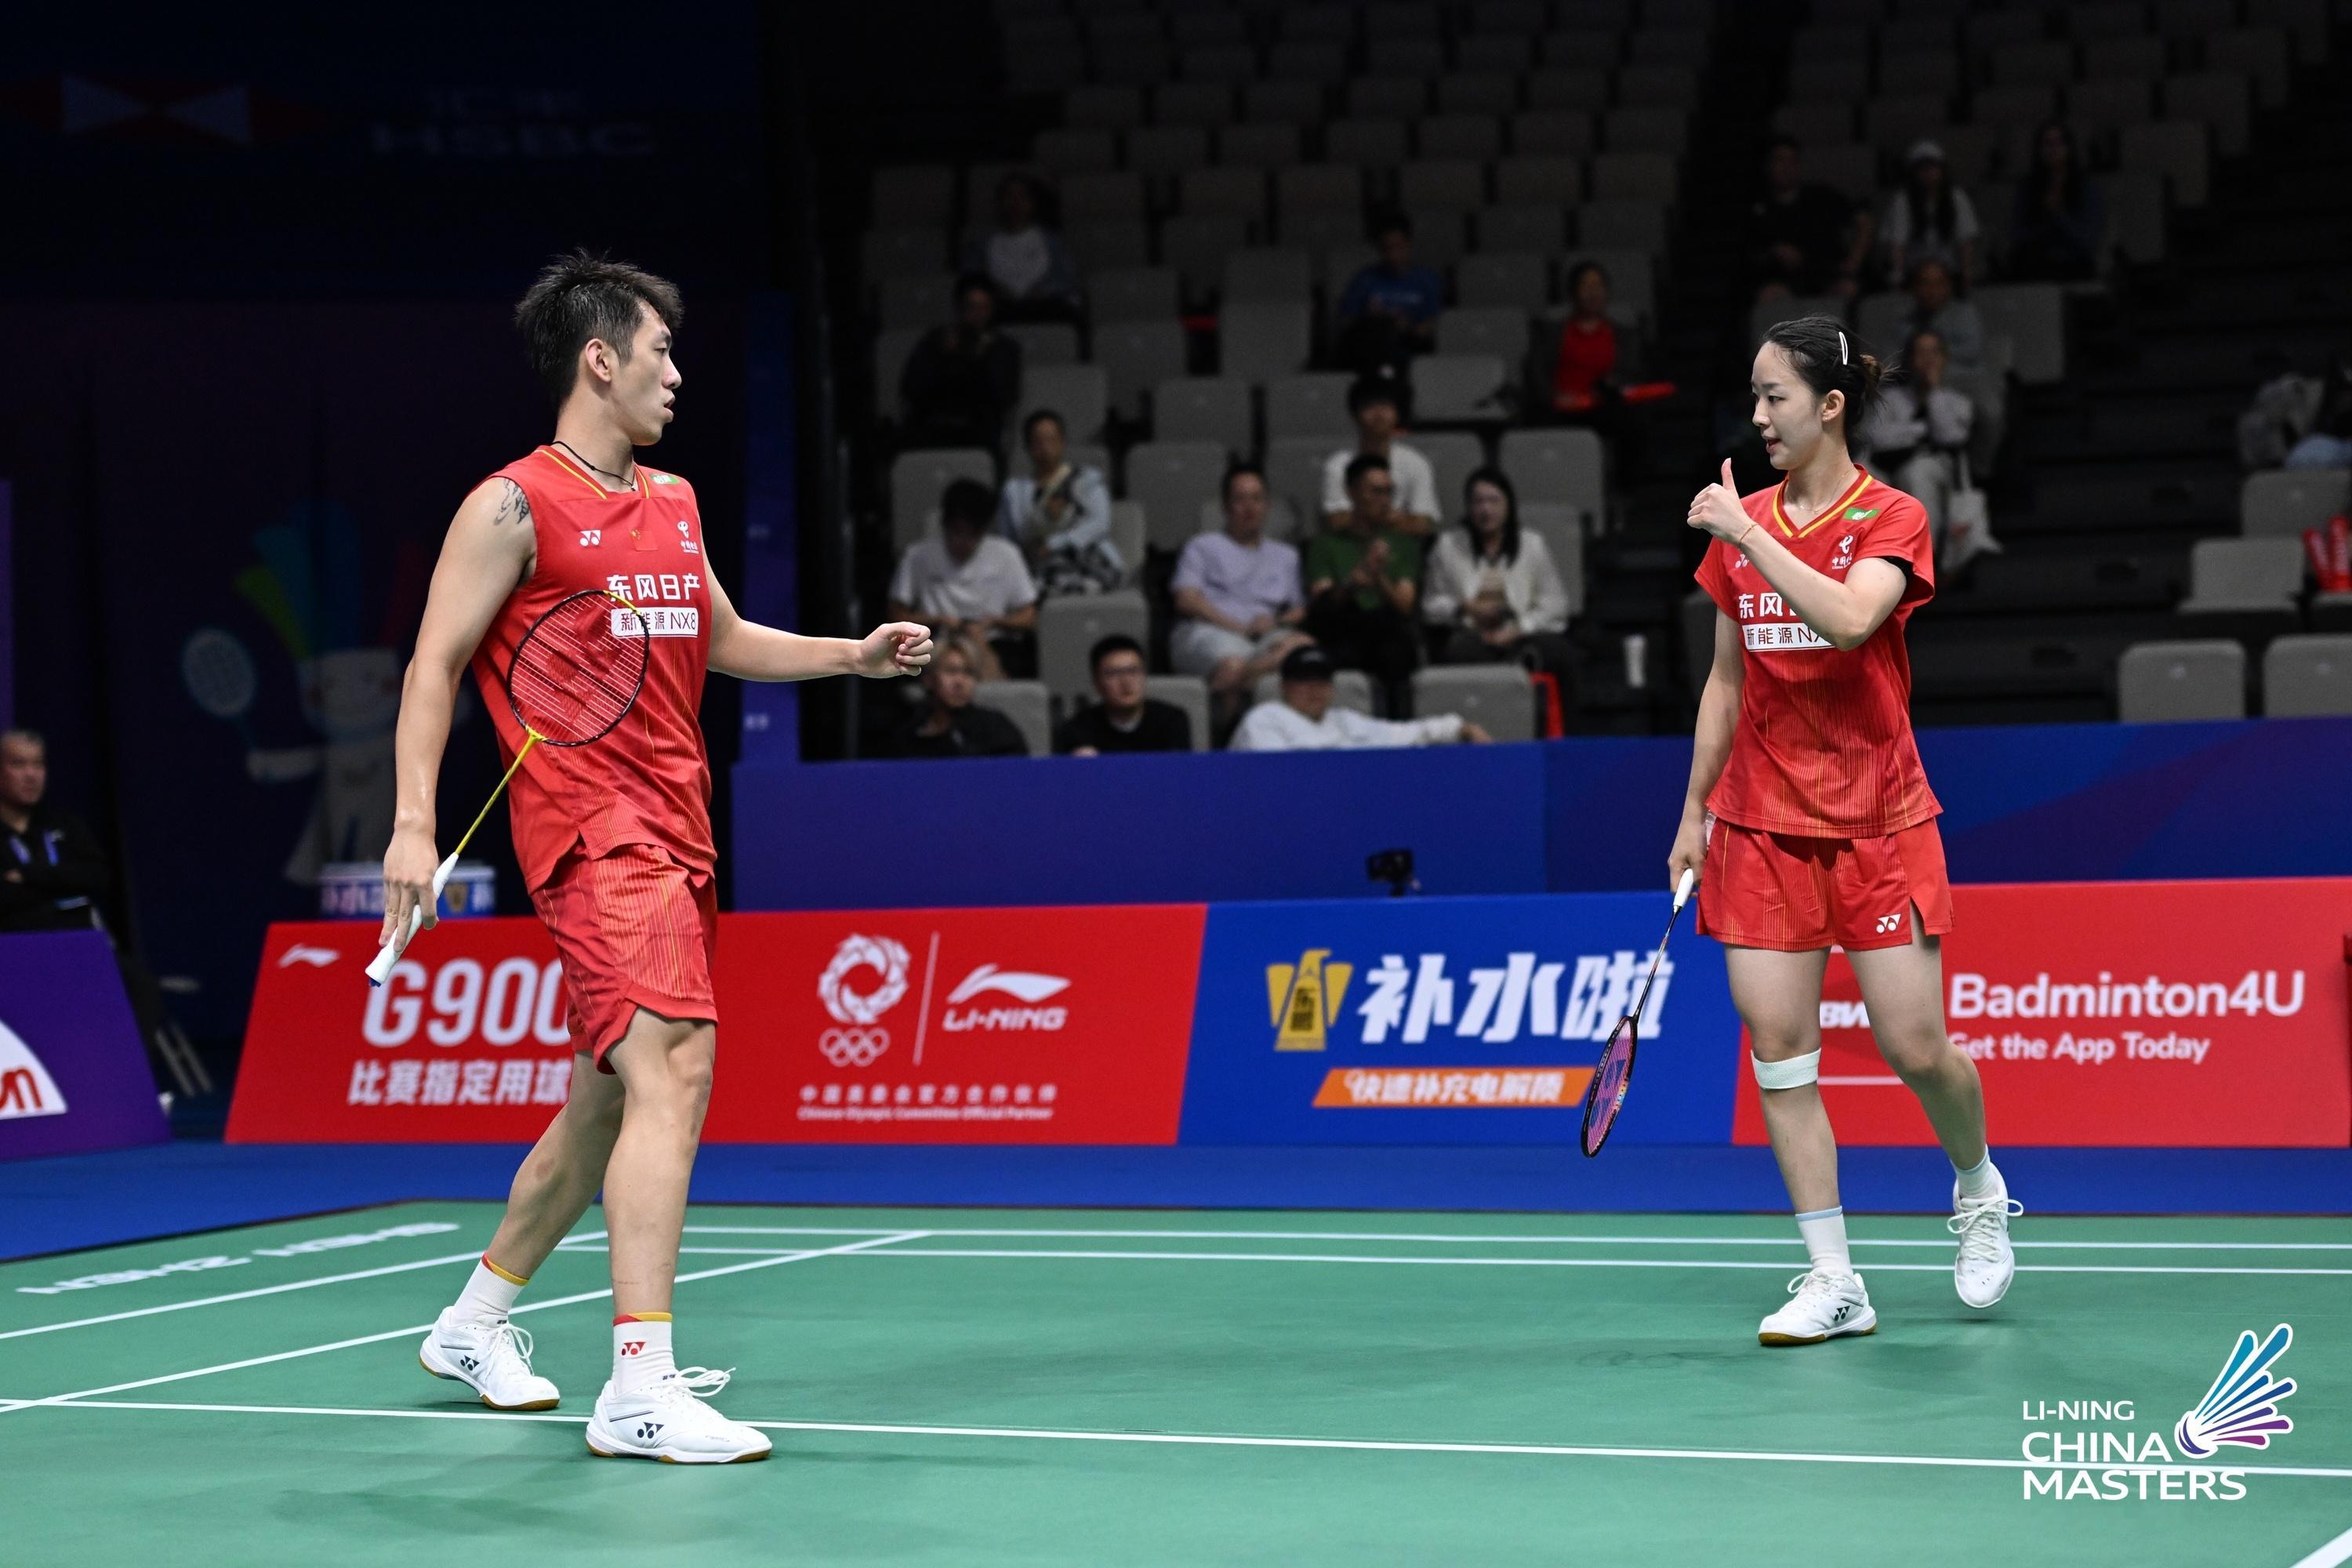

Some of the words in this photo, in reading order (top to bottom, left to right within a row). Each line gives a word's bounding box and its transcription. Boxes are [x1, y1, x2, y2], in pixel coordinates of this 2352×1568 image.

[371, 122, 657, 158] HSBC
[606, 573, 700, 601] 东风日产
[620, 612, 665, 631] 新能源
[670, 612, 697, 630] NX8
[1738, 592, 1797, 619] 东风
[1747, 627, 1794, 646] 新能源
[1359, 949, 1674, 1044] 补水啦
[1948, 970, 2306, 1019] Badminton4U
[2001, 1033, 2048, 1060] the
[2052, 1033, 2117, 1065] App
[2121, 1031, 2211, 1065] Today
[347, 1058, 573, 1105] 比赛指定用球
